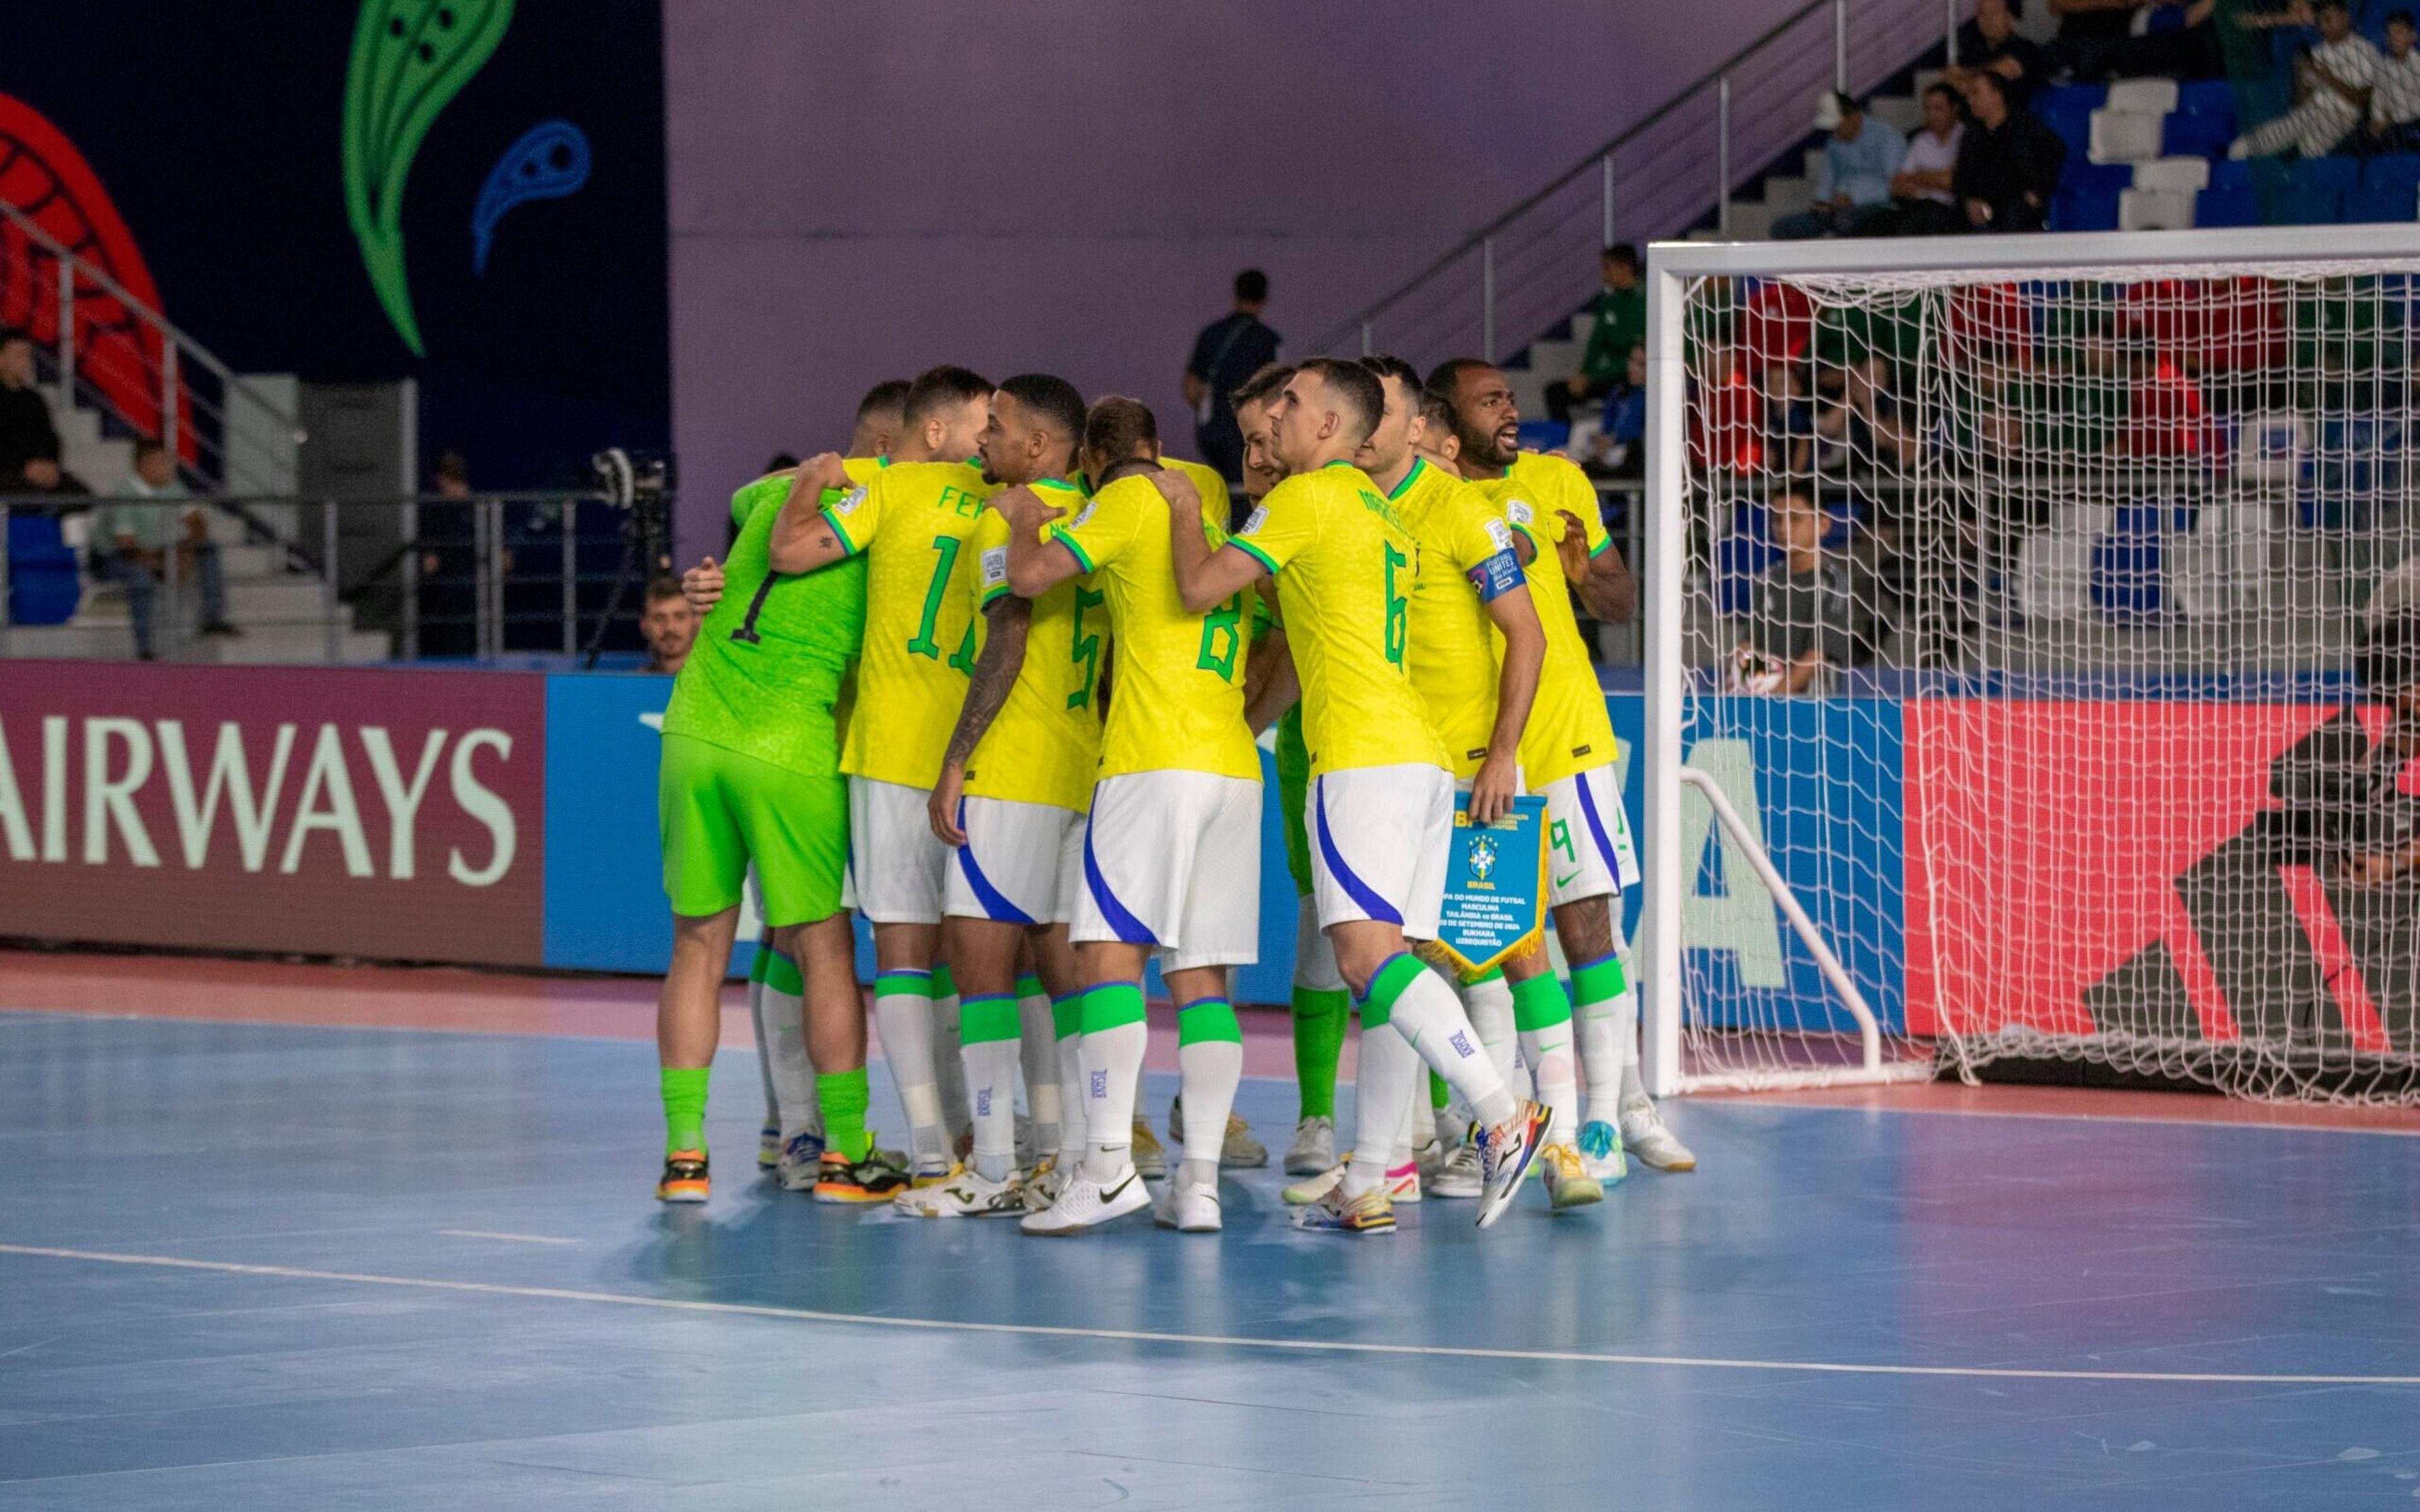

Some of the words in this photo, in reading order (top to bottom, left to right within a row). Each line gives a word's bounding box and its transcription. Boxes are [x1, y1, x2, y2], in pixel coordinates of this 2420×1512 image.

[1487, 559, 1514, 575] UNITES
[1385, 539, 1407, 674] 6
[1196, 590, 1242, 685] 8
[1066, 585, 1103, 711] 5
[1550, 818, 1576, 863] 9
[1466, 881, 1496, 890] BRASIL
[1465, 895, 1490, 903] MUNDO
[1501, 896, 1526, 905] FUTSAL
[1461, 903, 1499, 912] MASCULINA
[1446, 910, 1482, 920] TAILÂNDIA
[1490, 914, 1514, 922] BRASIL
[1458, 920, 1494, 929] SETEMBRO
[1462, 929, 1496, 937] BUKHARA
[1455, 937, 1502, 947] UZBEQUISTÃO
[1090, 1068, 1107, 1098] BRASIL
